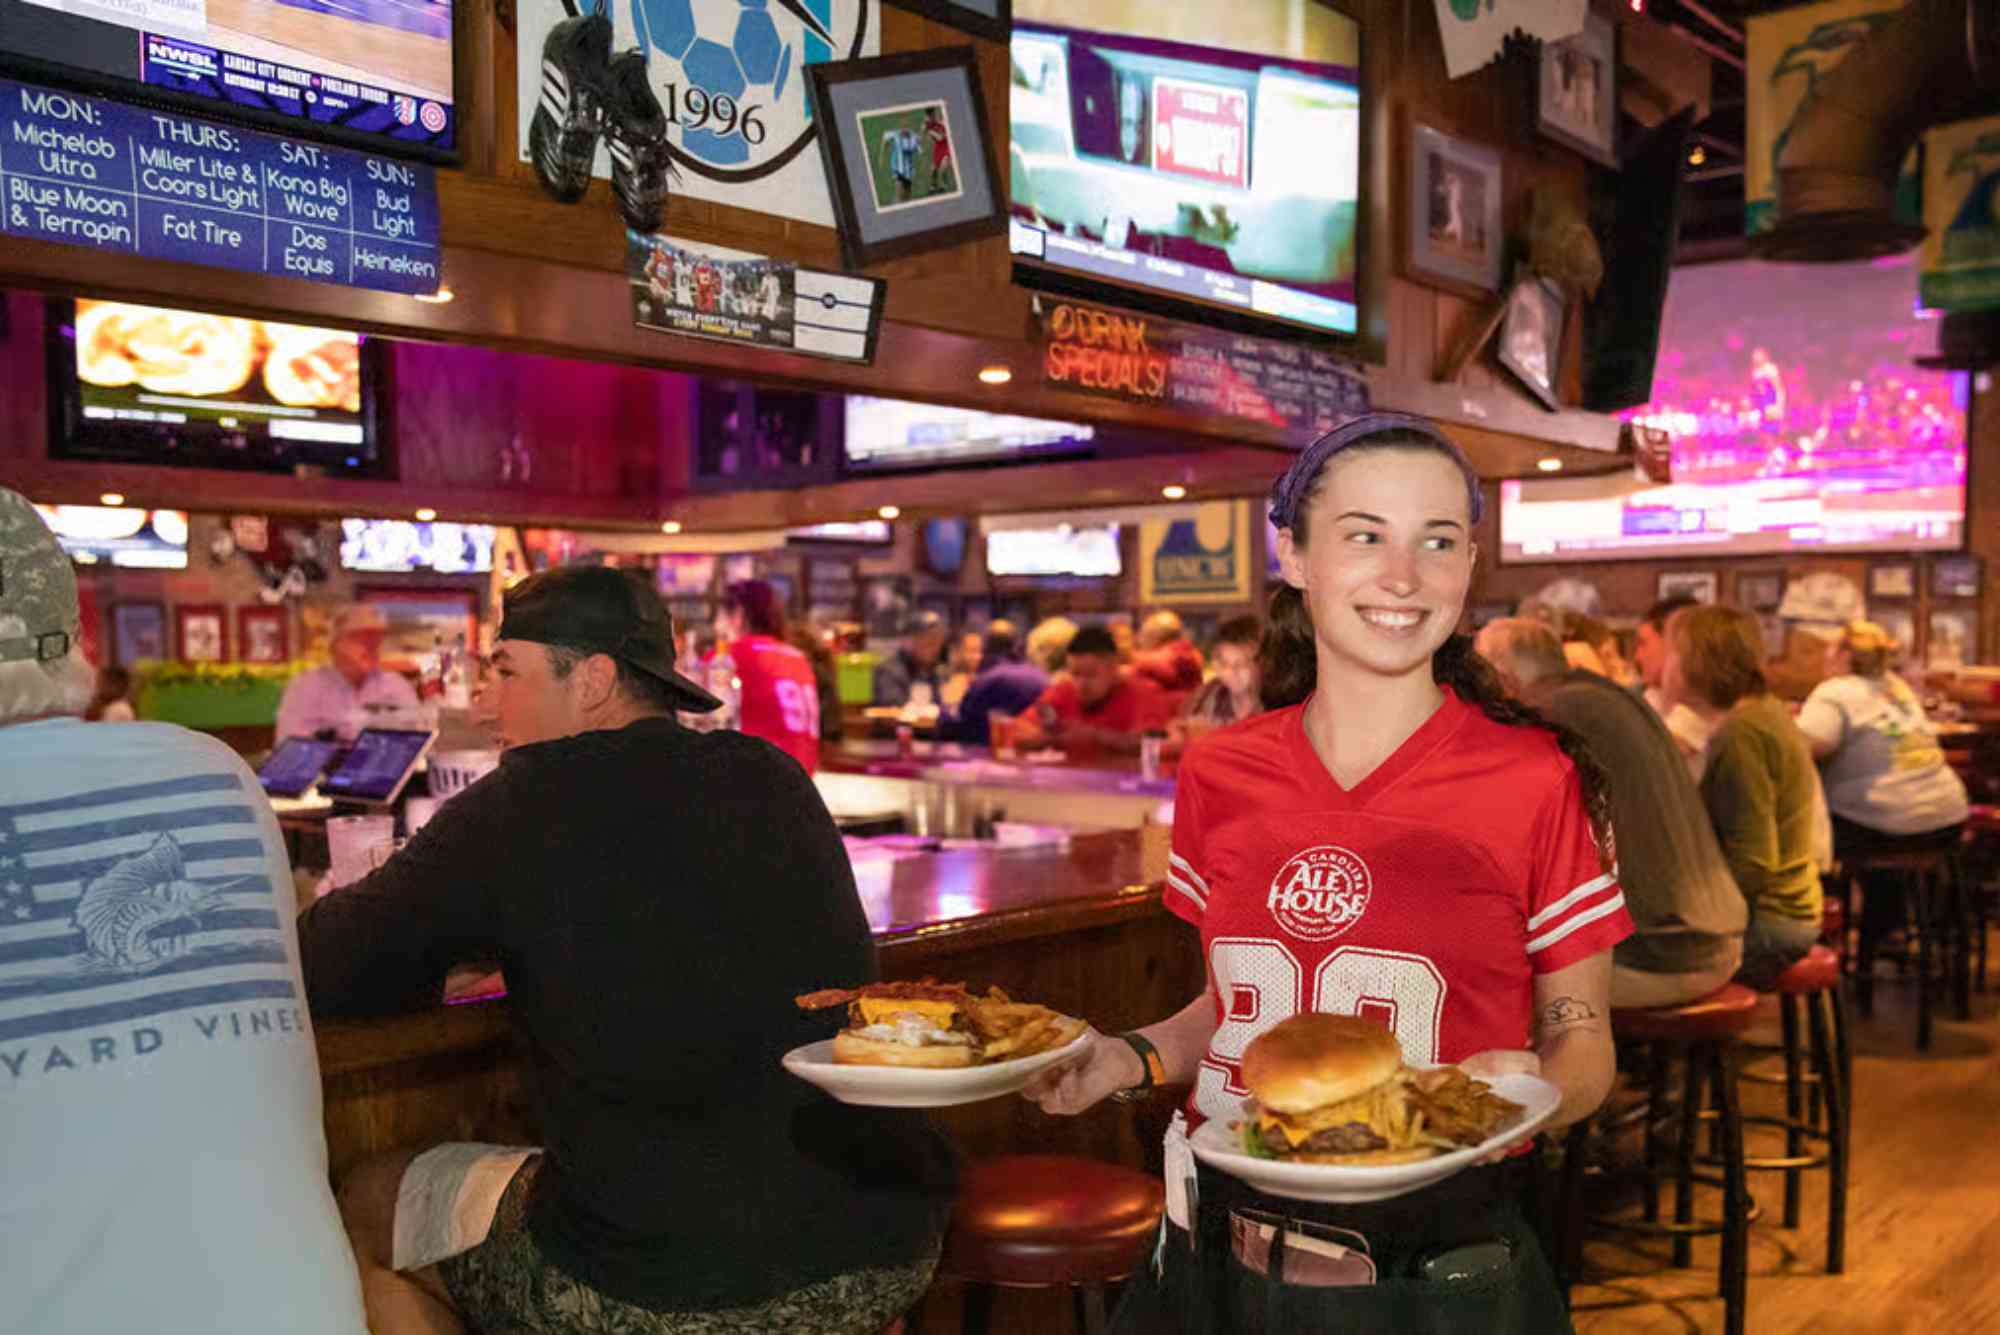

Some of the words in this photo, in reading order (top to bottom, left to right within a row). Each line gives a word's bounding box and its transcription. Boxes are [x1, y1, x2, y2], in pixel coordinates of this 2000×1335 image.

[21, 88, 102, 125] MON:
[663, 83, 765, 145] 1996
[13, 120, 116, 159] Michelob
[152, 115, 240, 152] THURS:
[39, 150, 97, 179] Ultra
[139, 143, 196, 173] Miller
[199, 155, 237, 181] Lite
[241, 163, 257, 184] &
[280, 142, 330, 170] SAT:
[366, 158, 415, 187] SUN:
[10, 177, 60, 207] Blue
[64, 187, 128, 218] Moon
[143, 168, 208, 199] Coors
[209, 180, 260, 210] Light
[267, 167, 317, 195] Kona
[319, 177, 348, 207] Big
[376, 188, 410, 213] Bud
[11, 203, 29, 226] &
[34, 206, 131, 245] Terrapin
[284, 193, 339, 221] Wave
[372, 209, 416, 239] Light
[163, 213, 197, 240] Fat
[201, 220, 242, 247] Tire
[292, 225, 327, 251] Dos
[285, 247, 335, 276] Equis
[354, 247, 436, 278] Heineken
[1049, 343, 1166, 398] SPECIALS!
[1289, 860, 1345, 893] ALE
[1308, 853, 1365, 890] CAROLINA
[1266, 885, 1366, 923] HOUSE
